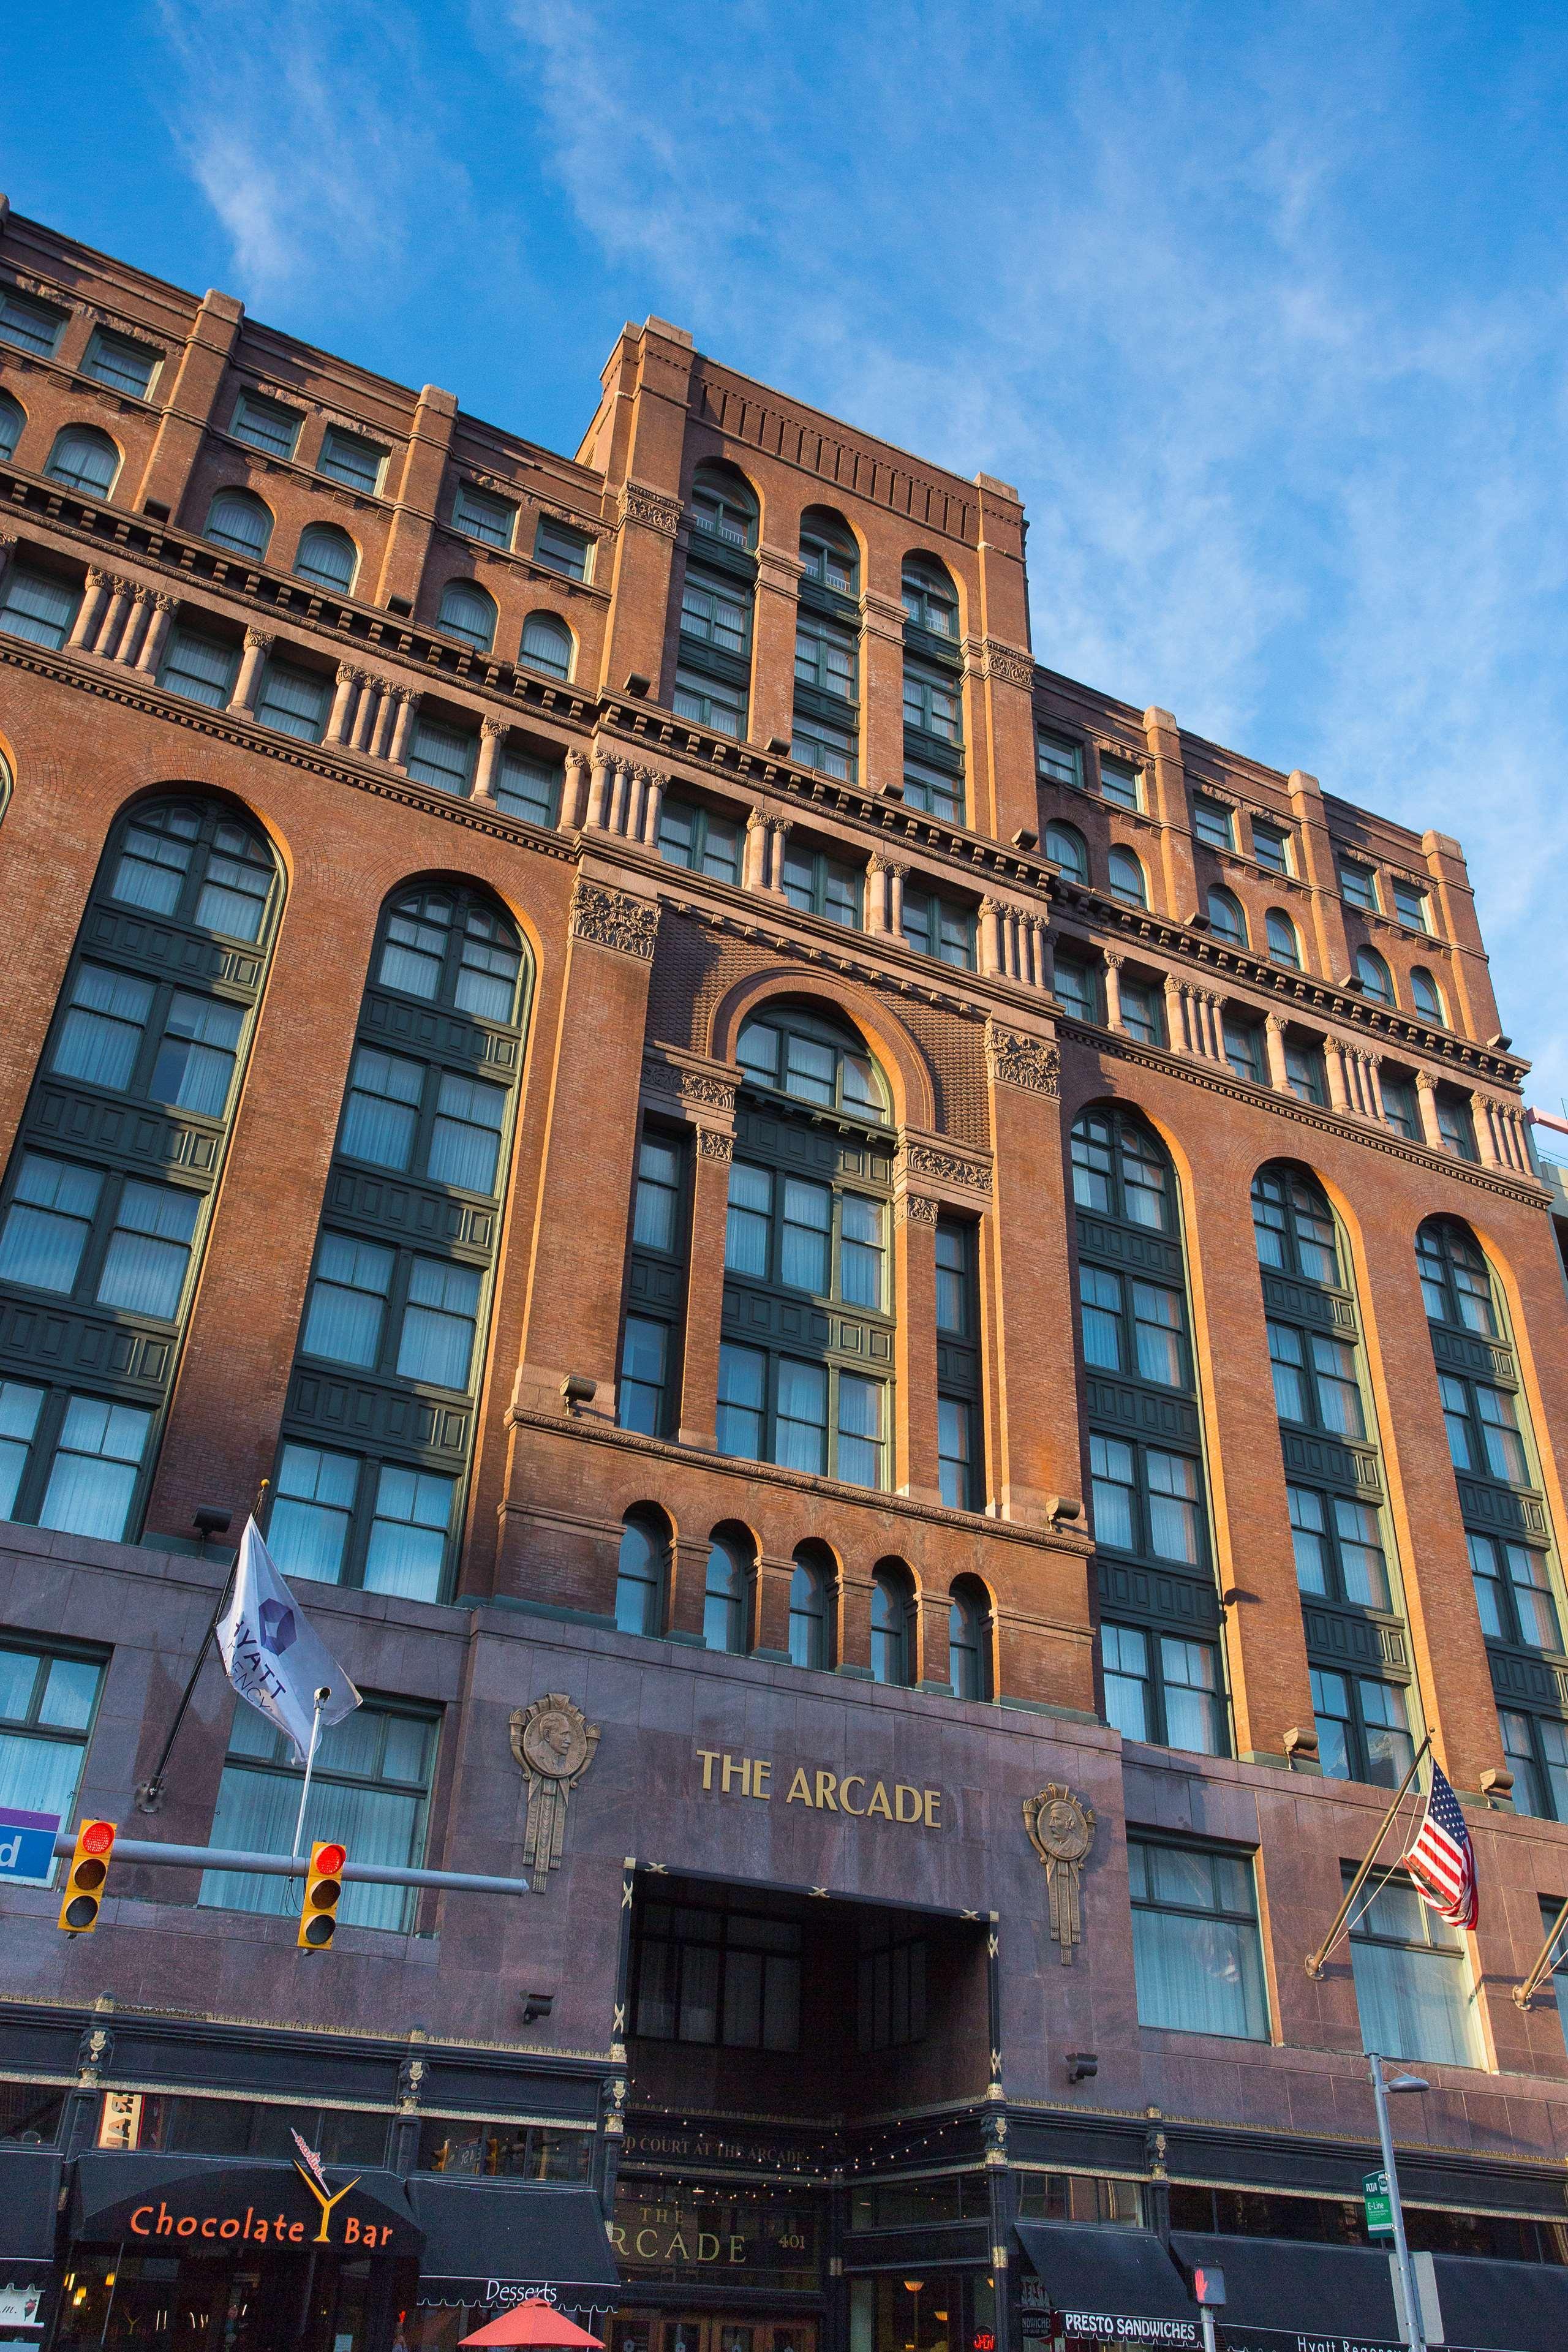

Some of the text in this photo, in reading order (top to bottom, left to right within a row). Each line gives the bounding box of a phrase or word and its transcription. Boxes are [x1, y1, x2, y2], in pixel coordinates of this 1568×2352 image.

[696, 1750, 941, 1828] THE ARCADE
[640, 2136, 688, 2154] COURT
[639, 2207, 684, 2225] THE
[1367, 2201, 1384, 2211] E-Line
[130, 2202, 393, 2248] Chocolate Bar
[778, 2235, 805, 2249] 401
[486, 2280, 557, 2302] Desserts
[1065, 2313, 1195, 2340] PRESTO SANDWICHES
